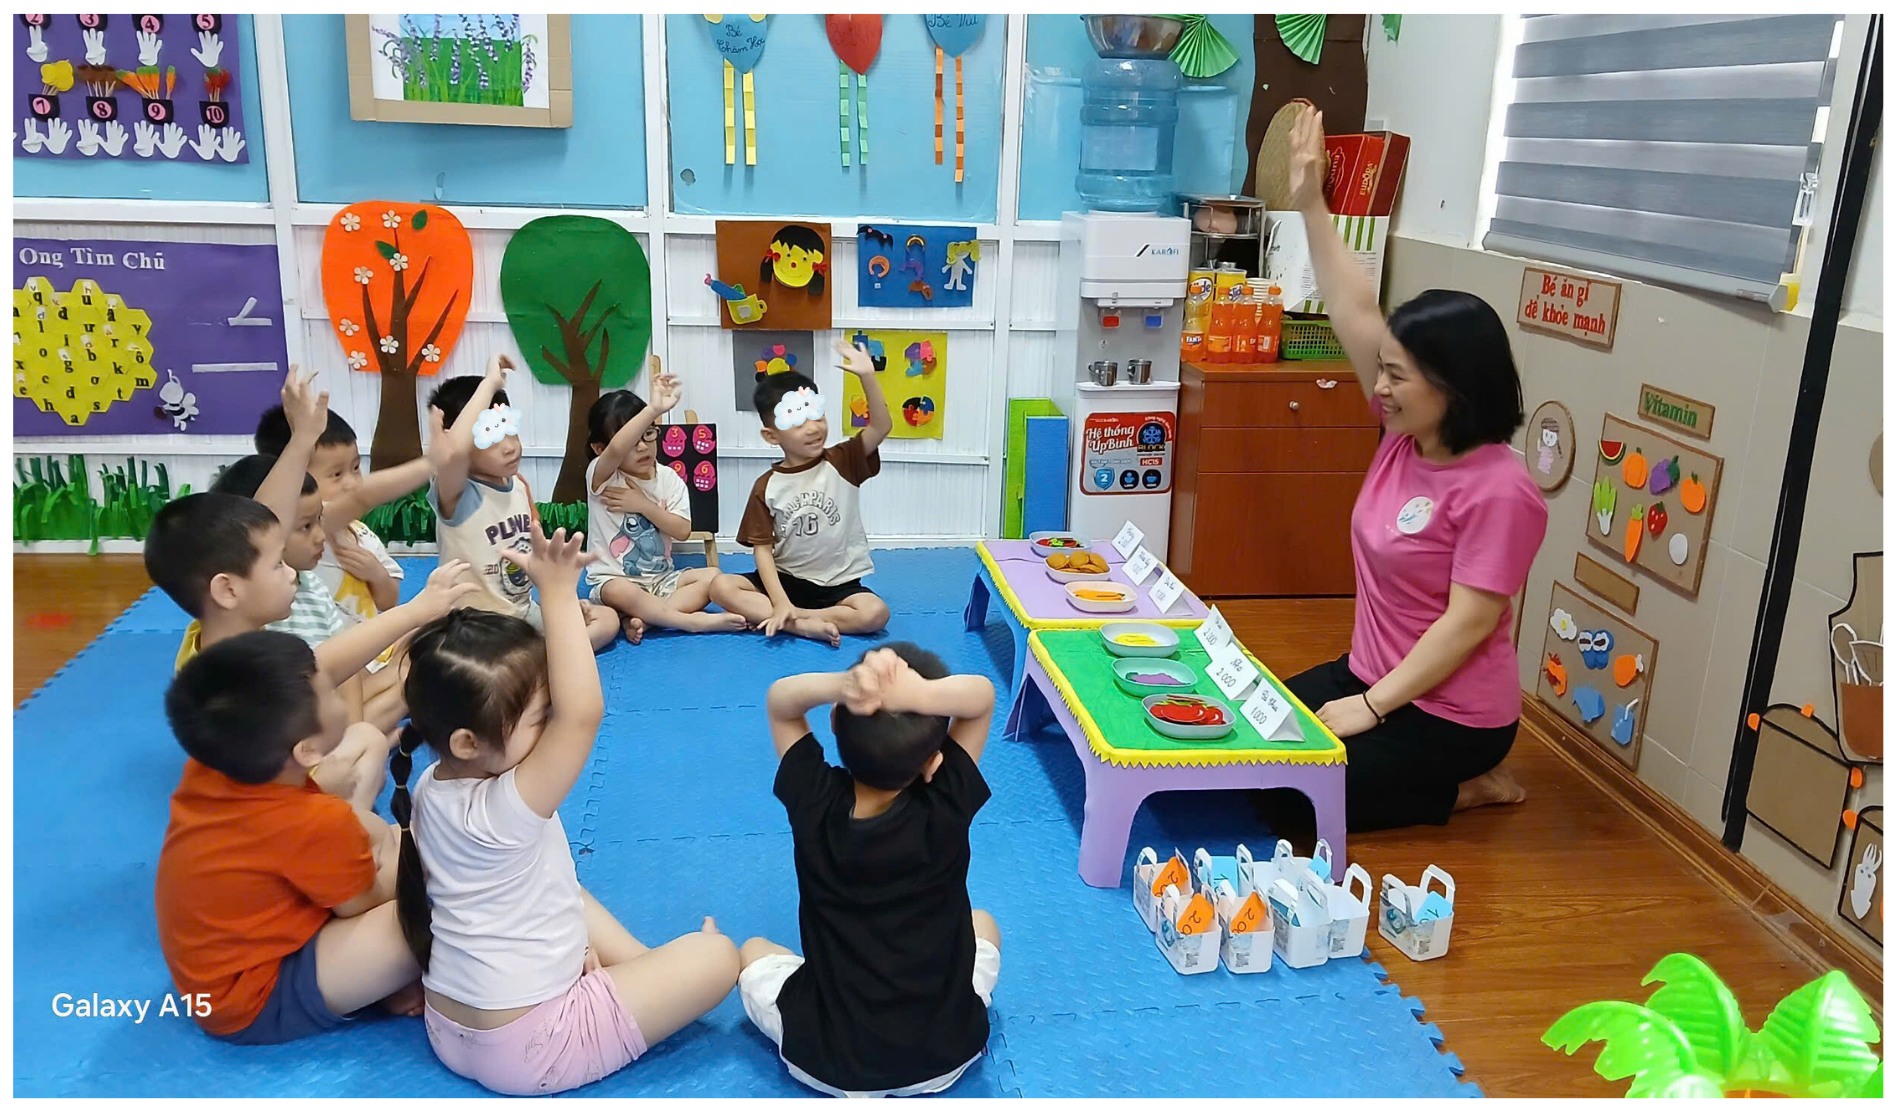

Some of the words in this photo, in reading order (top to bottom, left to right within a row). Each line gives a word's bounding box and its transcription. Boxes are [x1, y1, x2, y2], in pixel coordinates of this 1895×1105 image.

[86, 14, 95, 26] 3
[144, 18, 155, 32] 4
[202, 14, 211, 28] 5
[37, 100, 47, 113] 7
[97, 103, 108, 116] 8
[152, 104, 160, 118] 9
[208, 107, 222, 121] 10
[19, 247, 64, 269] Ong
[70, 247, 115, 266] Tìm
[1541, 274, 1557, 297] Bé
[1560, 278, 1574, 299] ăn
[33, 292, 43, 305] q
[82, 295, 92, 305] u
[1573, 313, 1606, 336] mạnh
[111, 339, 119, 347] r
[39, 348, 47, 357] o
[86, 349, 97, 361] b
[64, 361, 74, 373] g
[112, 362, 123, 375] k
[135, 377, 149, 387] m
[117, 388, 122, 399] t
[44, 399, 54, 411] h
[93, 401, 100, 410] s
[1645, 391, 1697, 429] Vitamin
[671, 428, 679, 438] 3
[698, 428, 706, 439] 5
[675, 463, 682, 473] 9
[701, 464, 709, 474] 6
[1101, 474, 1108, 482] 2
